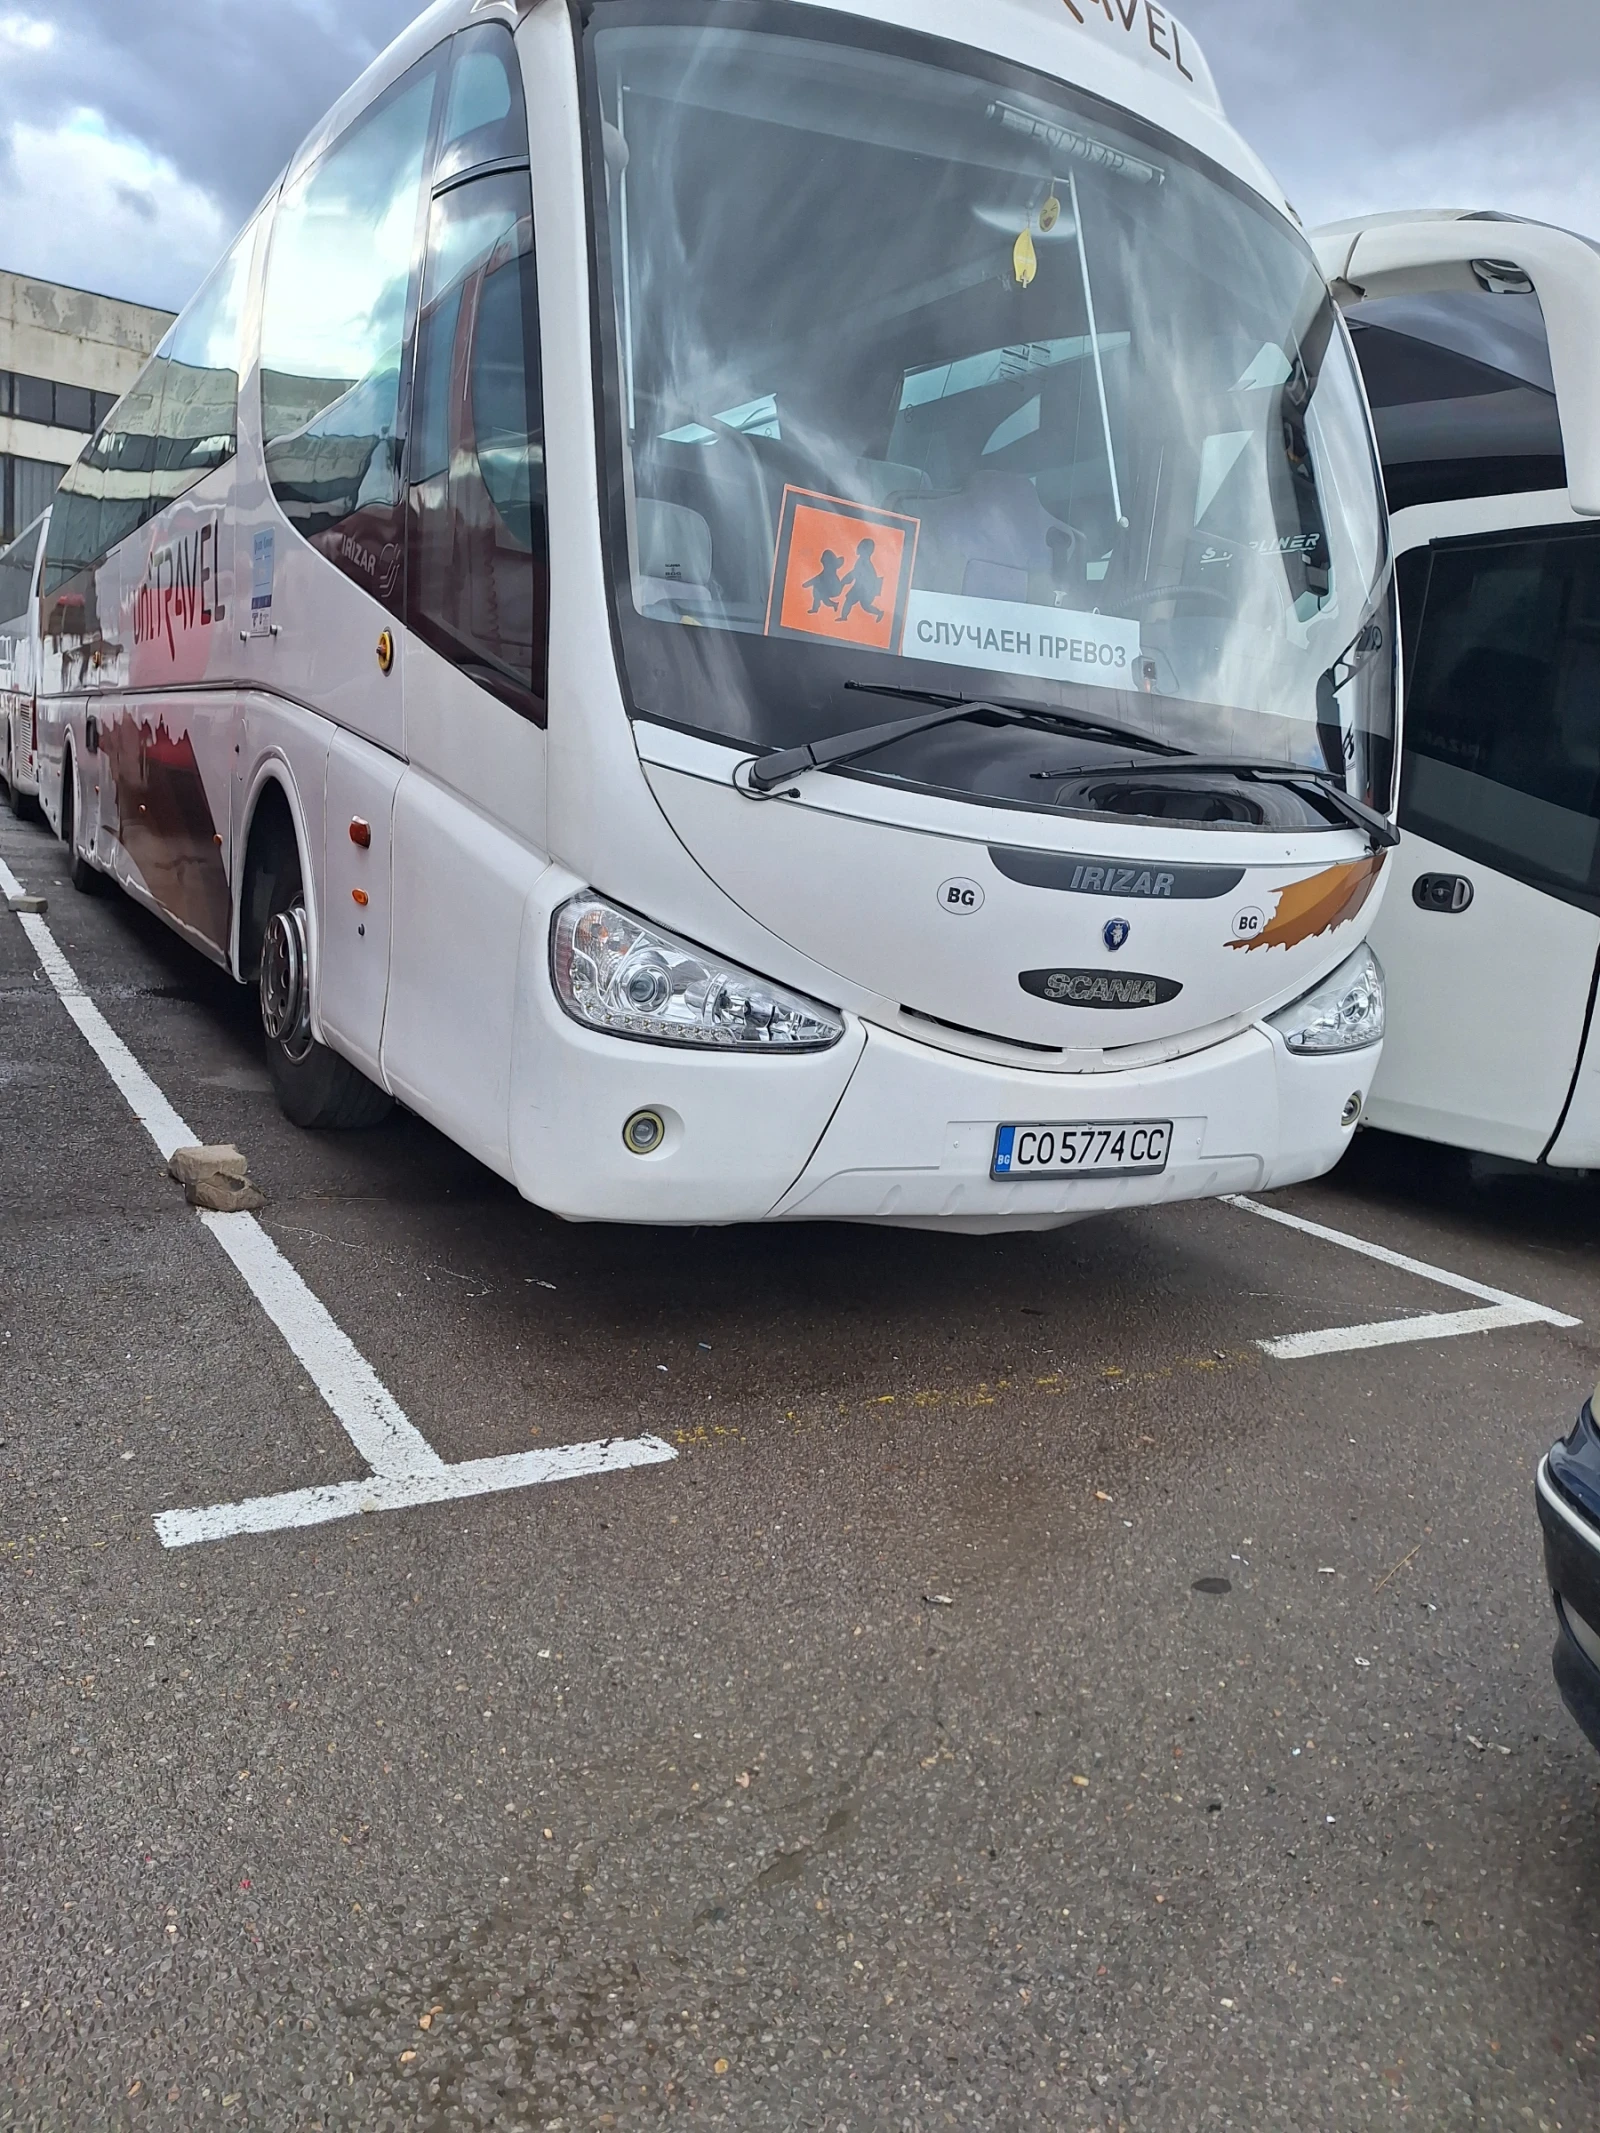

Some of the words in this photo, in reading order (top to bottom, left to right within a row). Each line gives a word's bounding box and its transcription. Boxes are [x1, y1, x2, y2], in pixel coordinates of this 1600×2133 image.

[341, 534, 376, 576] IRIZAR
[916, 619, 1031, 655] СЛУЧАЕН
[1039, 634, 1126, 668] ПРЕВОЗ
[1070, 865, 1175, 896] IRIZAR
[946, 887, 975, 906] BG
[1238, 916, 1258, 930] BG
[1044, 973, 1157, 1003] SCANIA
[997, 1154, 1010, 1165] BG
